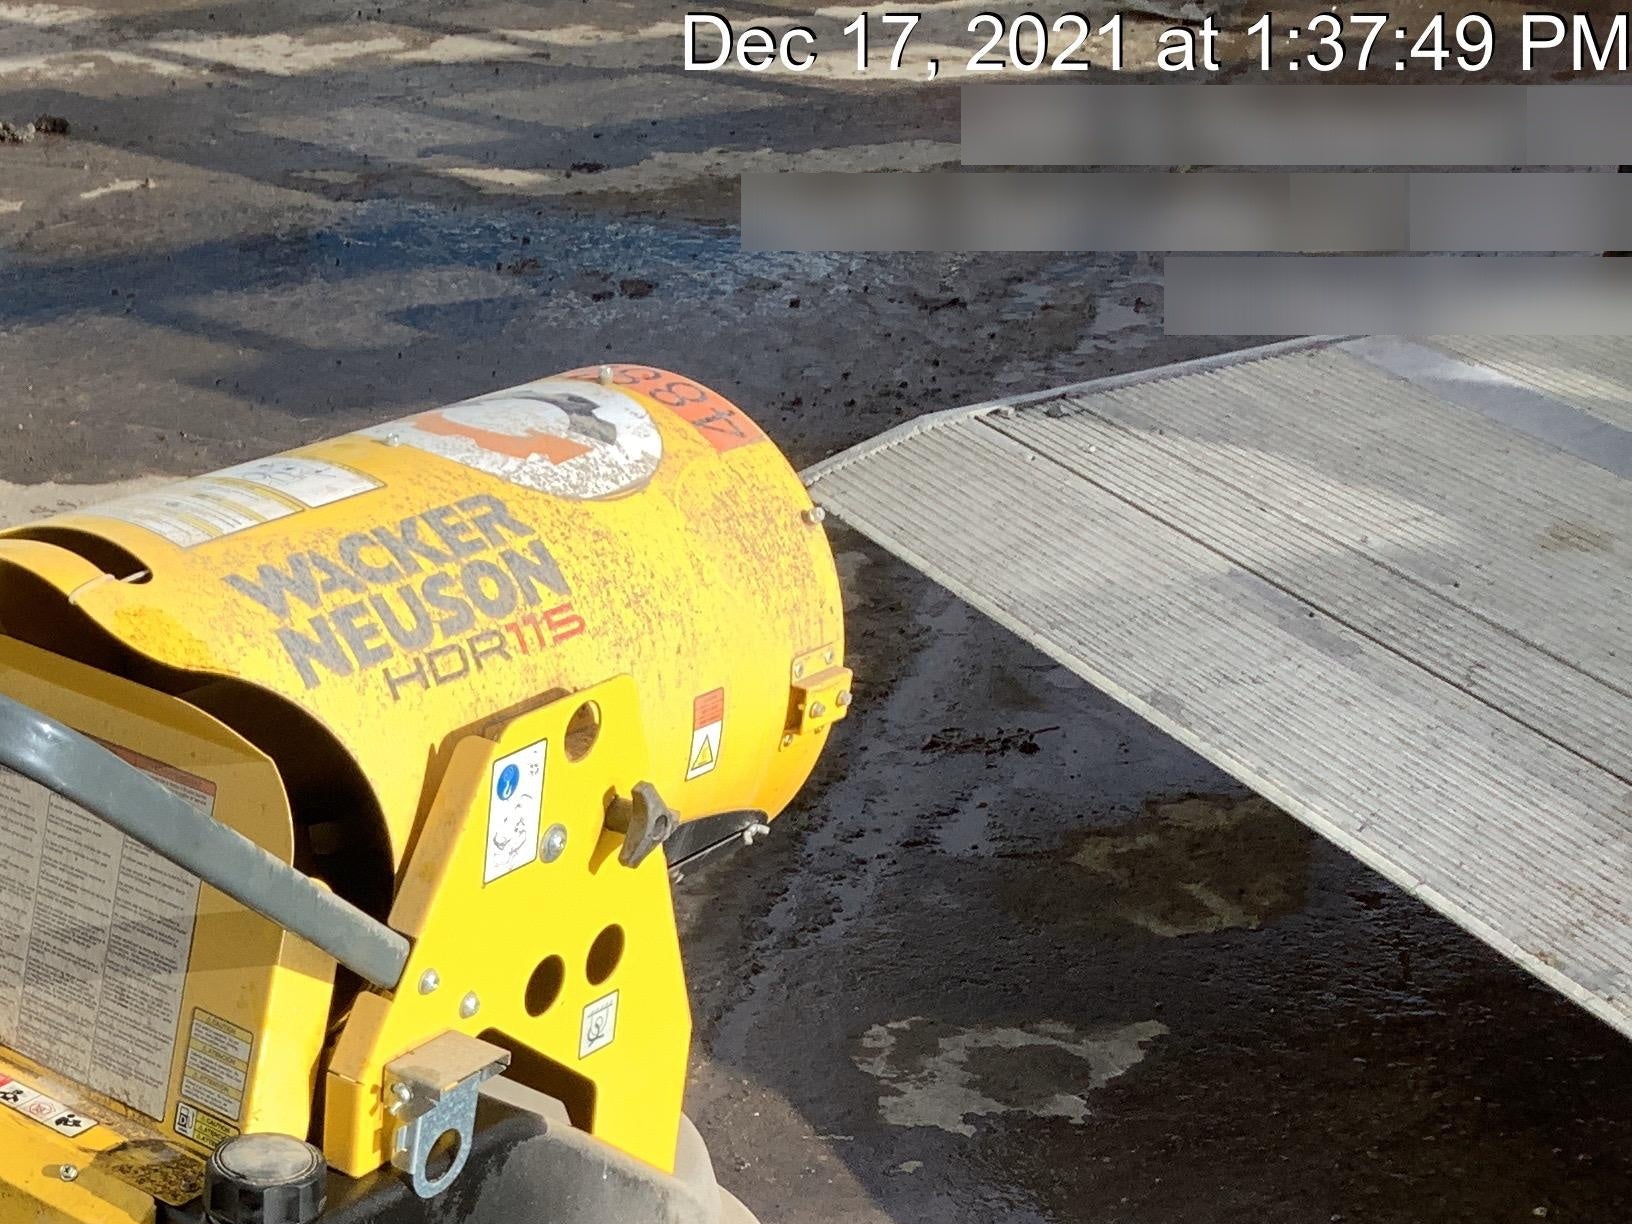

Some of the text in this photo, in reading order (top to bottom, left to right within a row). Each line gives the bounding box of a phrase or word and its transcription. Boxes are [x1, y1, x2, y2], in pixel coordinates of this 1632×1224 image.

[220, 493, 536, 619] WACKER
[276, 538, 572, 690] NEUSON
[382, 602, 586, 701] HDR115
